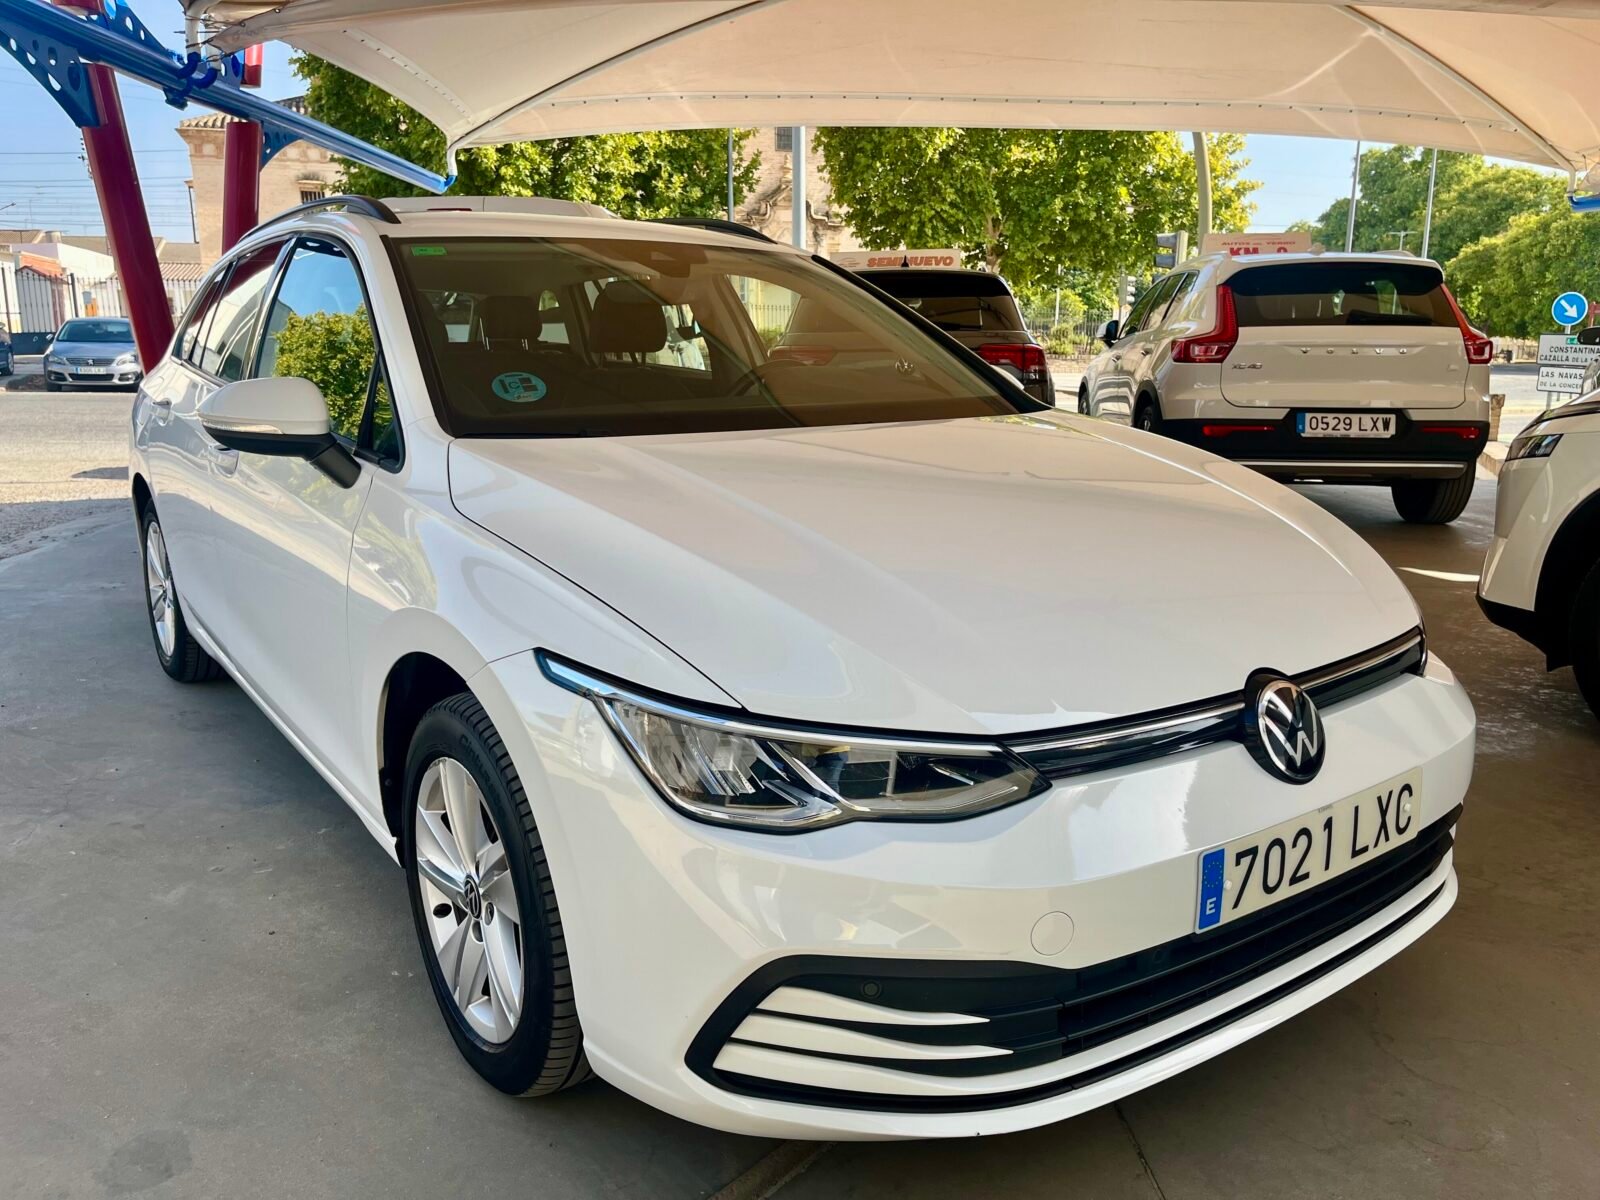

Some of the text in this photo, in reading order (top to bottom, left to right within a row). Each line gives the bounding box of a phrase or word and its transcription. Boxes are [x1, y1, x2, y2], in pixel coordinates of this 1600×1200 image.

[1229, 247, 1259, 256] KM
[1300, 347, 1407, 355] VOLVO
[1550, 346, 1600, 354] CONSTANTINA
[1309, 416, 1353, 432] 0529
[1358, 416, 1392, 432] LXW
[1205, 782, 1414, 916] E 7021 LXC
